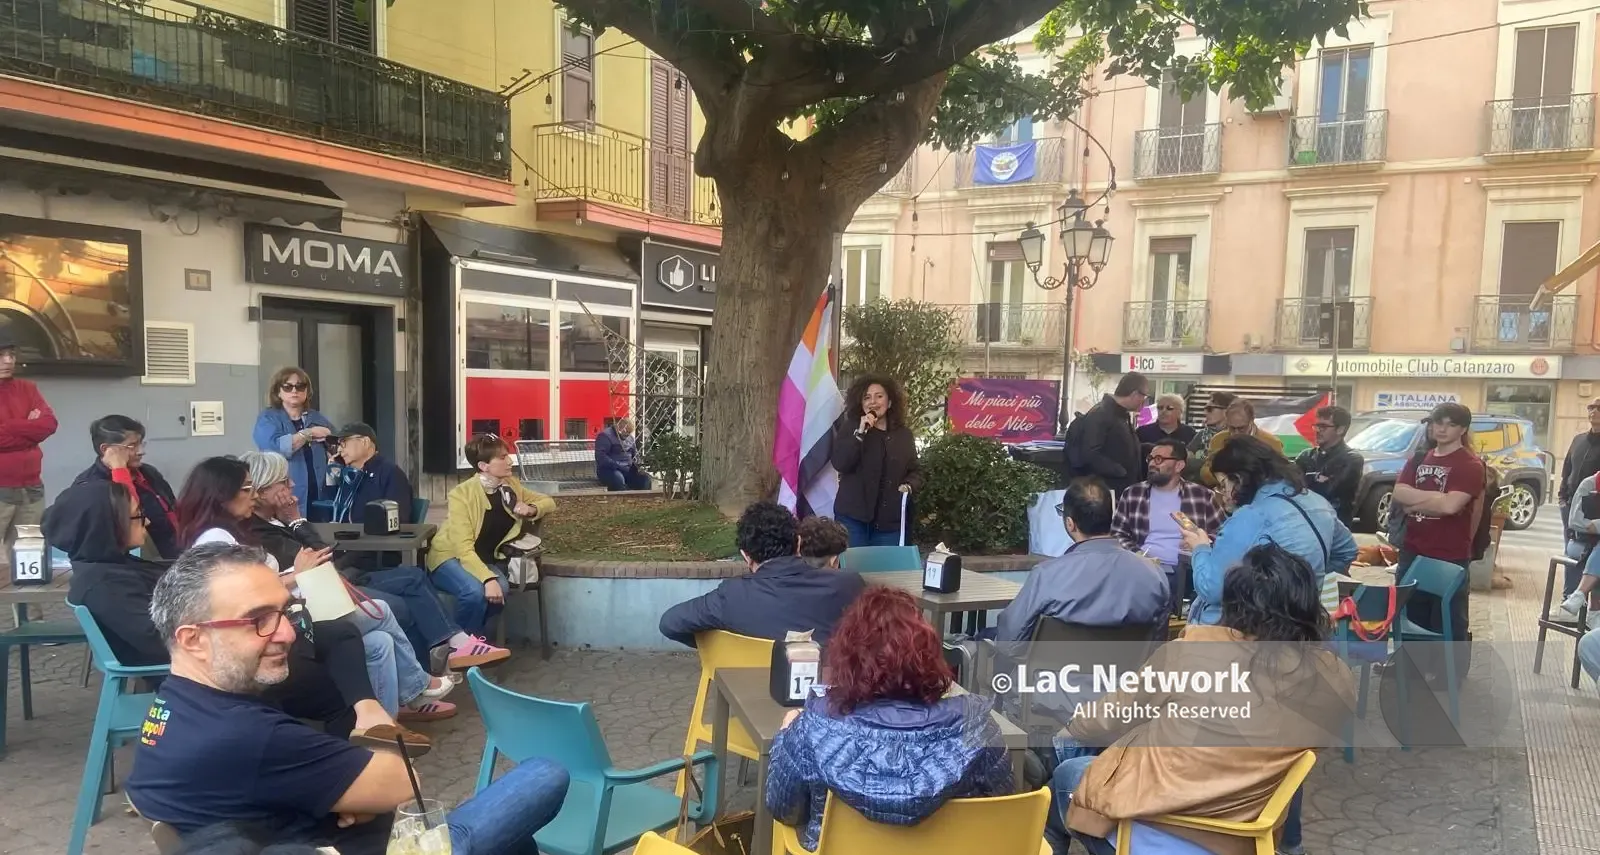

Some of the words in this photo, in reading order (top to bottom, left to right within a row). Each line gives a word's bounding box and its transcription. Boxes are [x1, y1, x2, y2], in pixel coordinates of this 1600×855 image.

[262, 233, 403, 277] MOMA
[1407, 359, 1439, 373] Club
[1444, 359, 1515, 374] Catanzaro
[962, 391, 985, 406] Mi
[981, 394, 1017, 411] piaci
[1395, 394, 1456, 402] ITALIANA
[964, 414, 996, 430] delle
[998, 415, 1034, 431] Nike
[389, 517, 398, 529] 18
[19, 561, 39, 575] 16
[794, 676, 815, 694] 17
